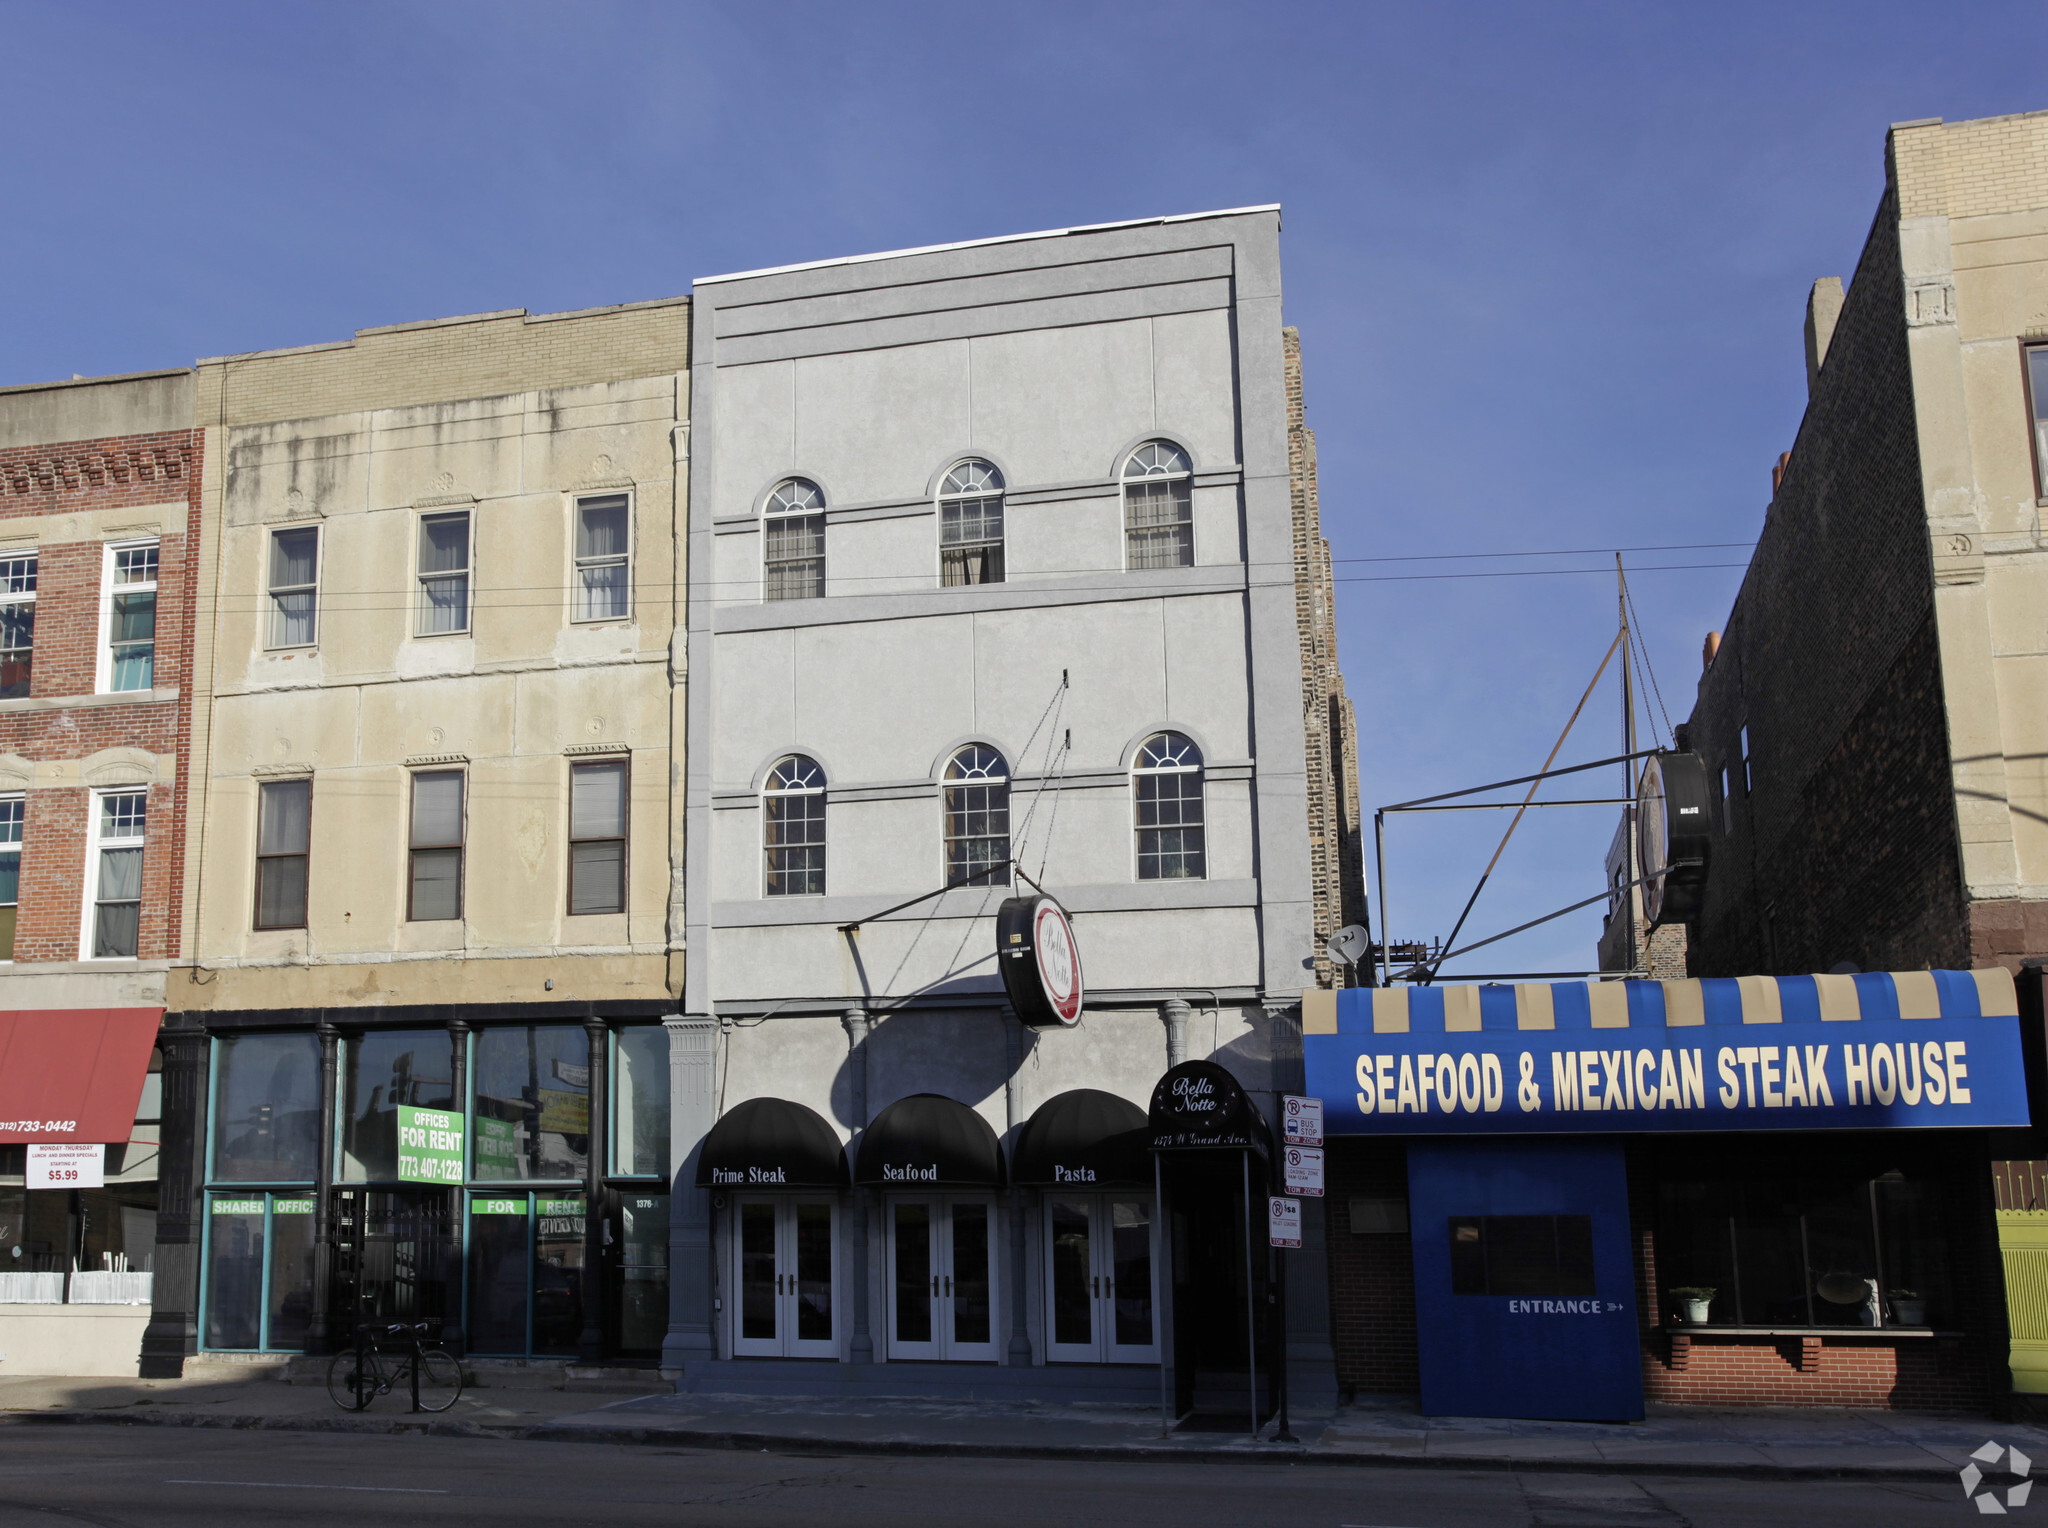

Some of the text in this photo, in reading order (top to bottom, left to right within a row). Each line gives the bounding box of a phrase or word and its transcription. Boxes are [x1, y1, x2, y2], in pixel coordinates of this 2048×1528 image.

[1356, 1041, 1972, 1115] SEAFOOD & MEXICAN STEAK HOUSE
[1172, 1077, 1215, 1096] Bella
[1175, 1094, 1217, 1112] Notte
[17, 1120, 76, 1132] 733-0442
[414, 1112, 449, 1129] OFFICES
[1301, 1120, 1314, 1128] BUS
[401, 1126, 462, 1151] FOR RENT
[1301, 1128, 1317, 1136] STOP
[48, 1170, 78, 1180] $5.99
[400, 1156, 463, 1180] 773 407-1228
[713, 1166, 786, 1183] Prime Steak
[883, 1163, 937, 1180] Seafood
[1054, 1165, 1096, 1181] Pasta
[214, 1201, 264, 1213] SHARED
[487, 1201, 514, 1213] FOR
[546, 1201, 579, 1213] RENT
[1509, 1300, 1601, 1314] ENTRANCE
